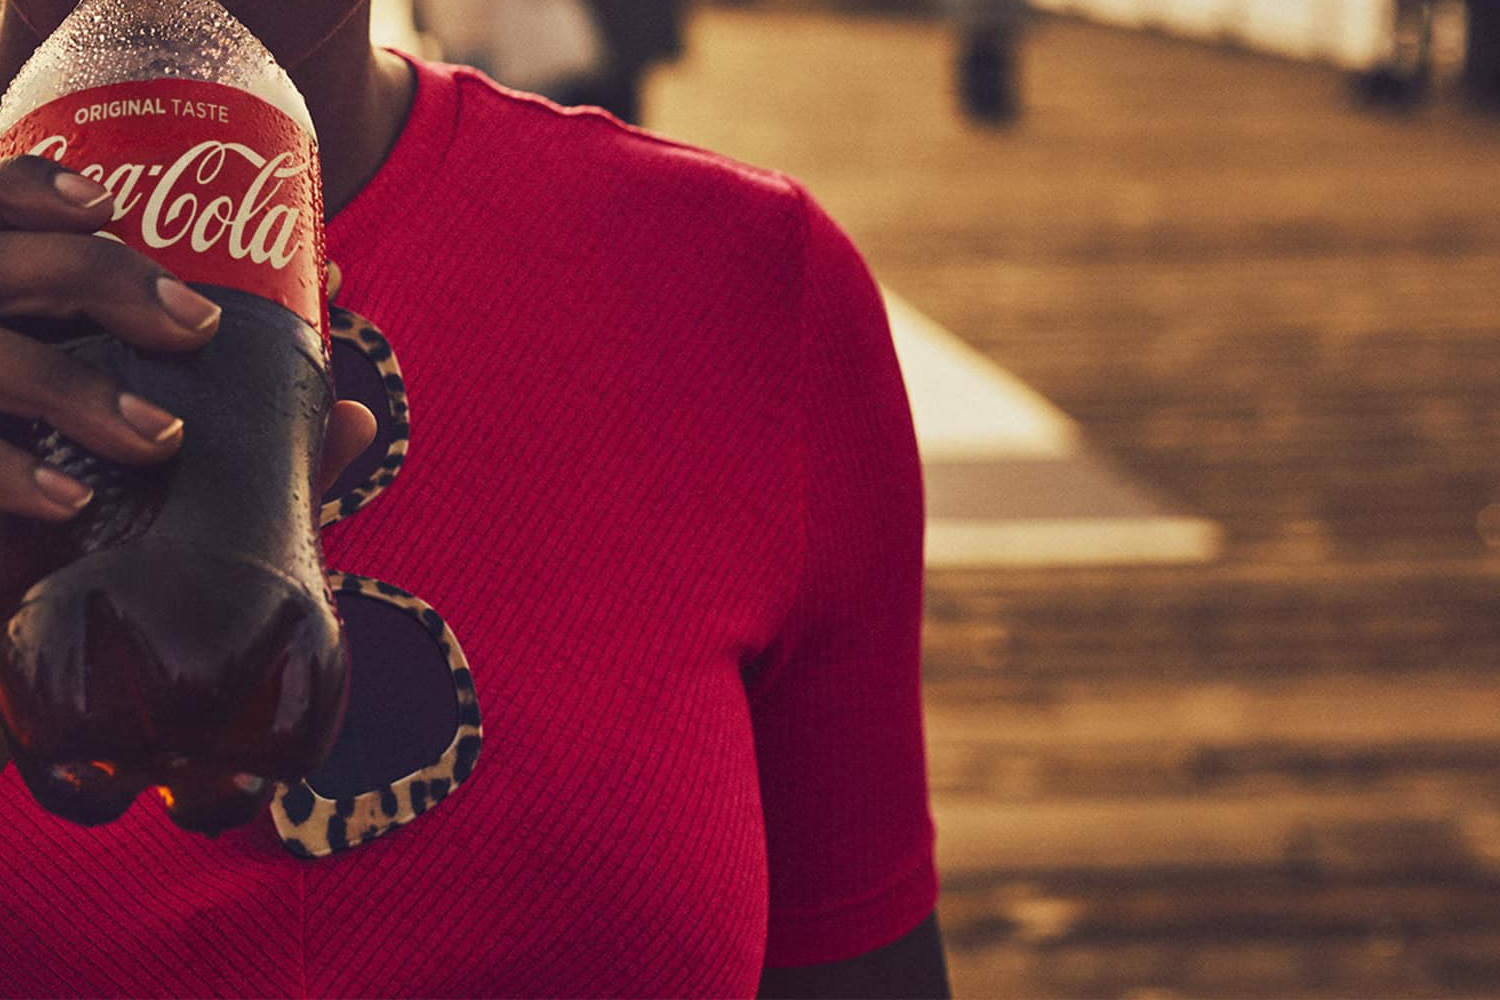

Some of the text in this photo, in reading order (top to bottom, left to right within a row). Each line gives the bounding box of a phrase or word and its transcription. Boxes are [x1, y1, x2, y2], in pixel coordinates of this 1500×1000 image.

[74, 98, 229, 125] ORIGINAL TASTE
[25, 135, 309, 270] a-Cola
